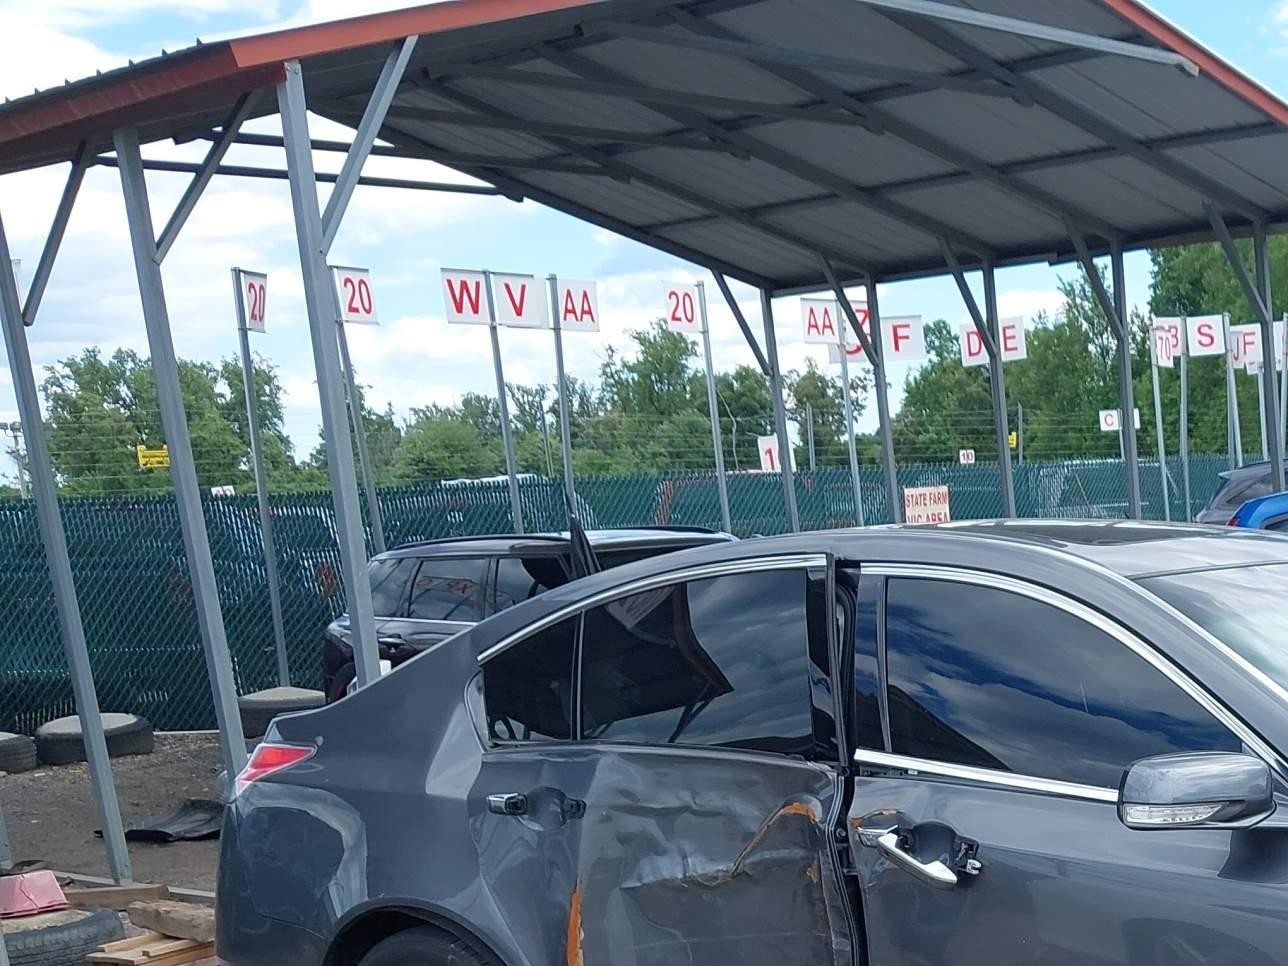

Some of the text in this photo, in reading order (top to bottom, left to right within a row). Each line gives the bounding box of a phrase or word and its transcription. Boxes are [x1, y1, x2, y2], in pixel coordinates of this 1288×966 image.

[248, 282, 266, 322] 20
[344, 277, 373, 315] 20
[447, 278, 481, 315] W
[504, 282, 527, 318] V
[563, 288, 596, 323] AA
[668, 290, 695, 324] 20
[807, 306, 836, 336] AA
[1197, 323, 1215, 347] S
[891, 323, 911, 353] F
[966, 330, 984, 358] D
[1002, 325, 1019, 352] E
[1158, 336, 1171, 361] 70
[1243, 332, 1256, 356] F
[1104, 413, 1114, 427] C
[906, 490, 948, 508] STATE FARM
